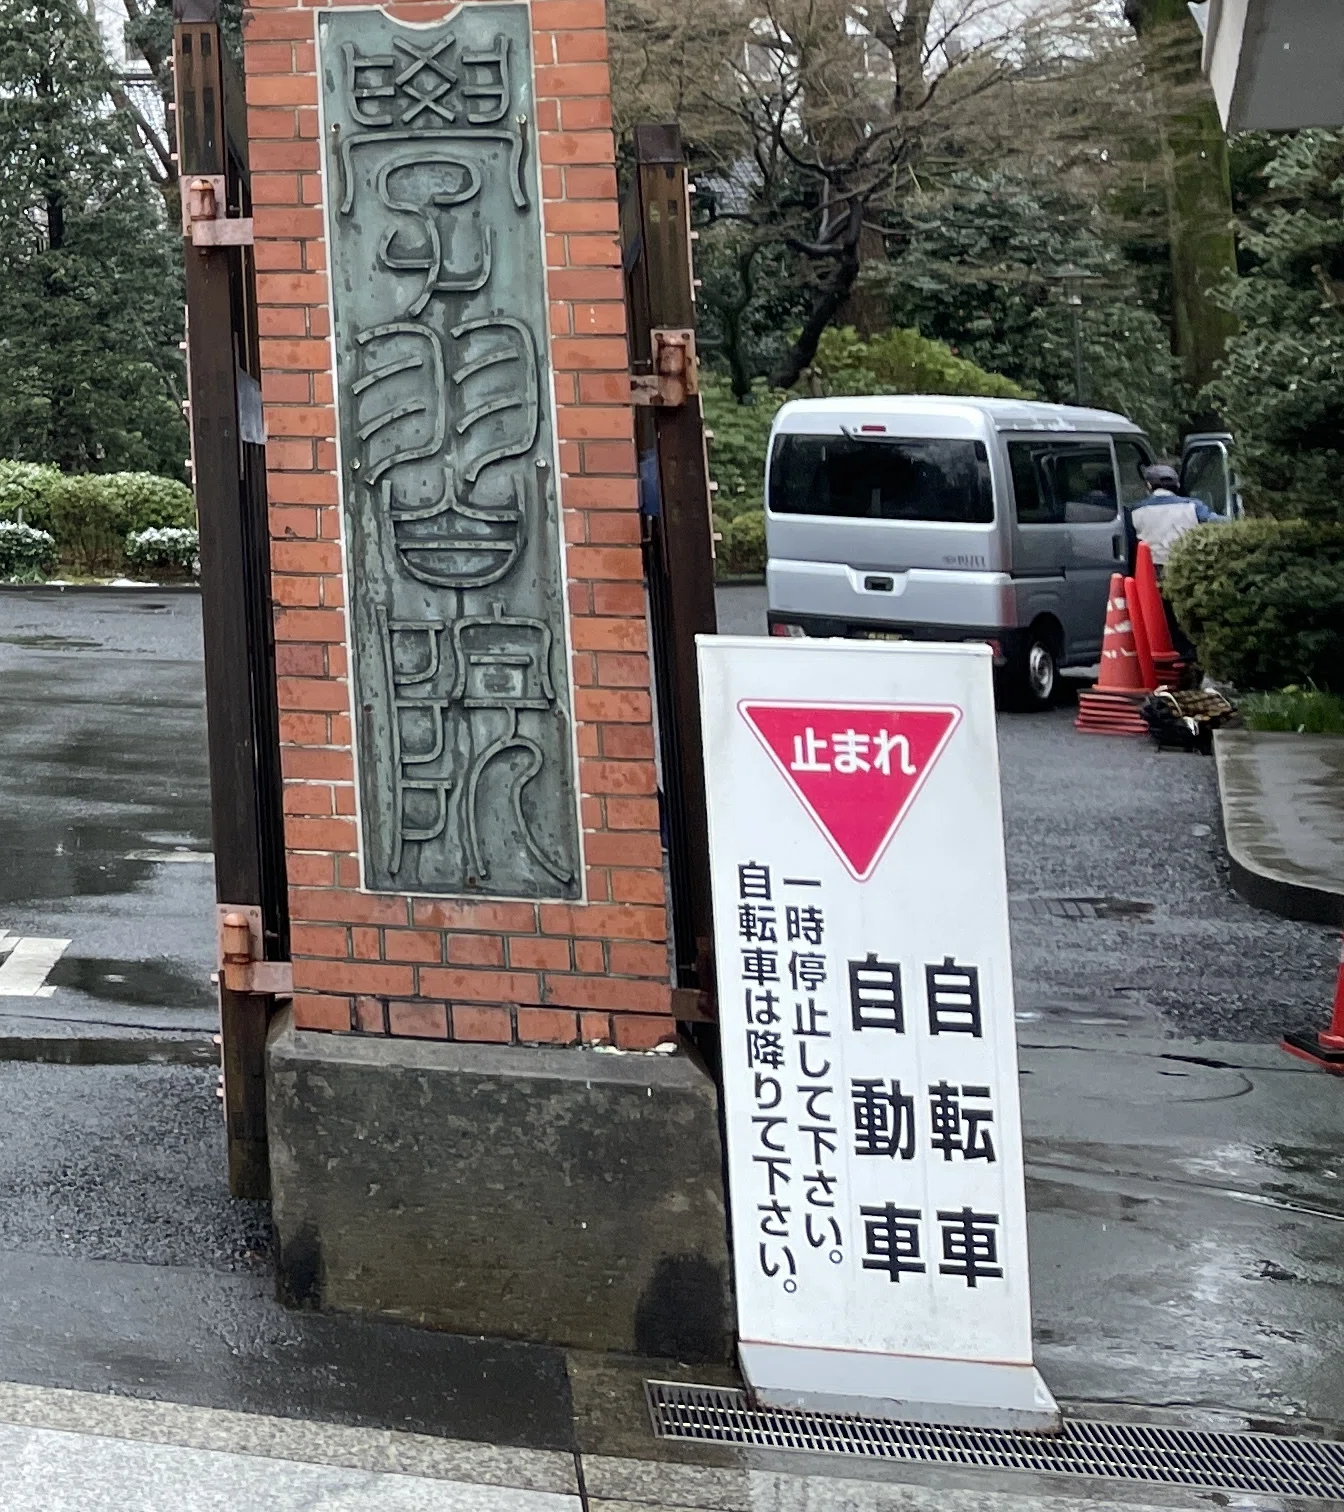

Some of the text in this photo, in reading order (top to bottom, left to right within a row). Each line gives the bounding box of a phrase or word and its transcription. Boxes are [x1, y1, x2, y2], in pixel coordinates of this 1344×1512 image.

[790, 728, 916, 777] 止まれ
[737, 861, 797, 1295] 自転車は降りて下さい。
[783, 877, 843, 1265] 一時停止して下さい。
[848, 952, 926, 1283] 自動車
[925, 956, 1004, 1288] 自転車
